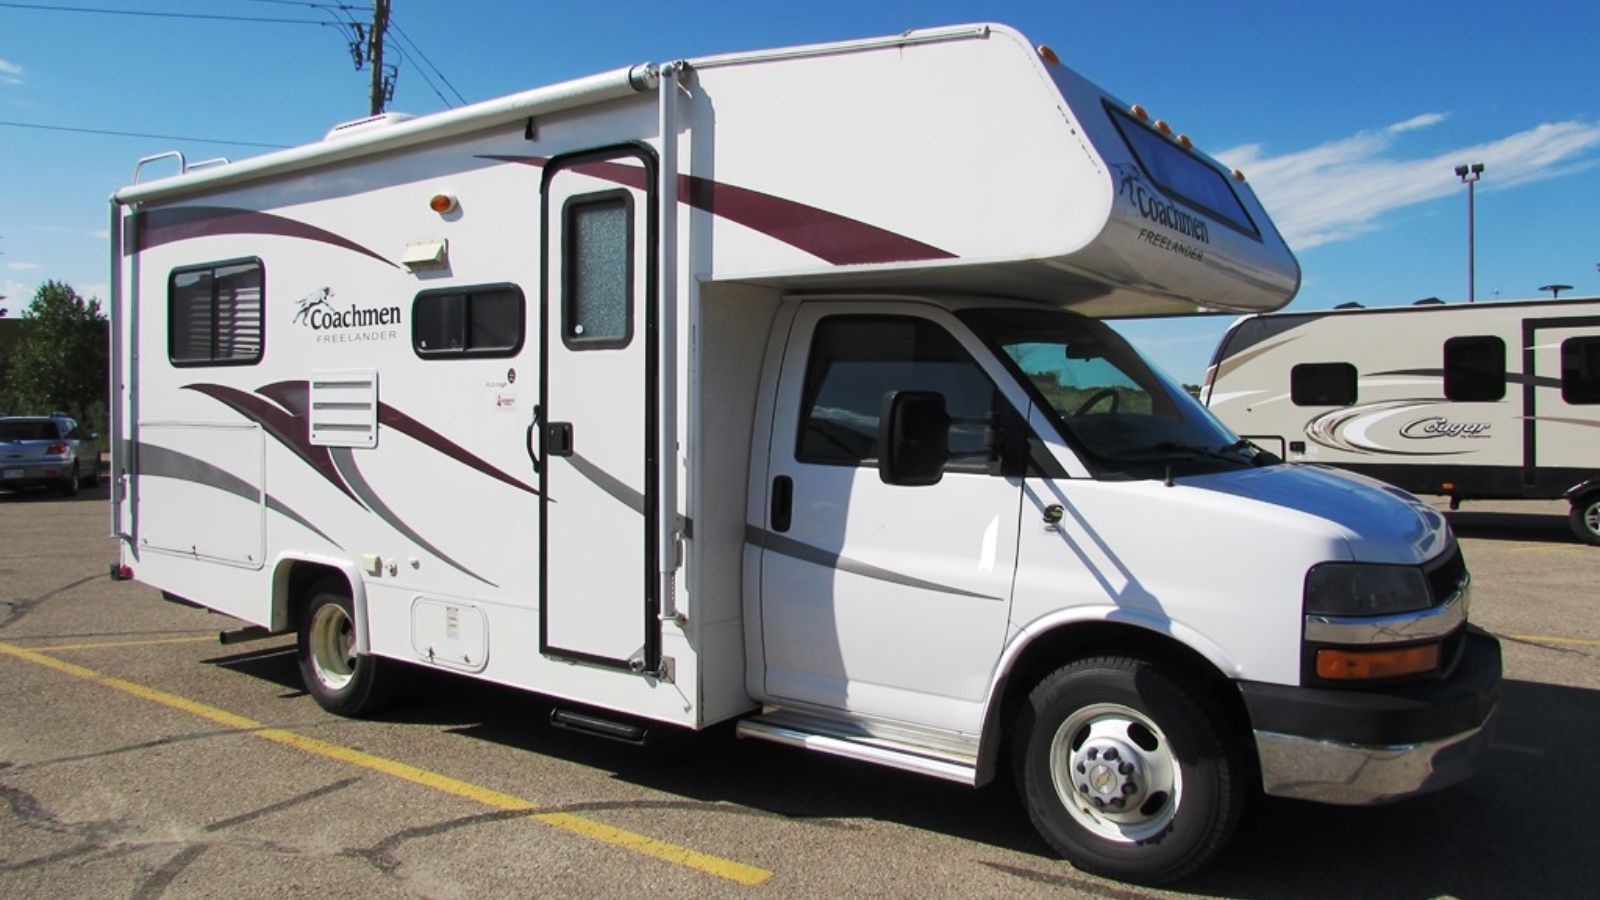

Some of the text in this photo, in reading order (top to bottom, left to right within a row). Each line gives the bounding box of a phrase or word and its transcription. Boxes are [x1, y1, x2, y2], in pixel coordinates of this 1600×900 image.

[1136, 186, 1210, 244] Coachmen
[1137, 228, 1204, 262] FREELANDER
[310, 304, 402, 330] Coachmen
[316, 330, 397, 344] FREELANDER
[1399, 416, 1491, 439] Cougar
